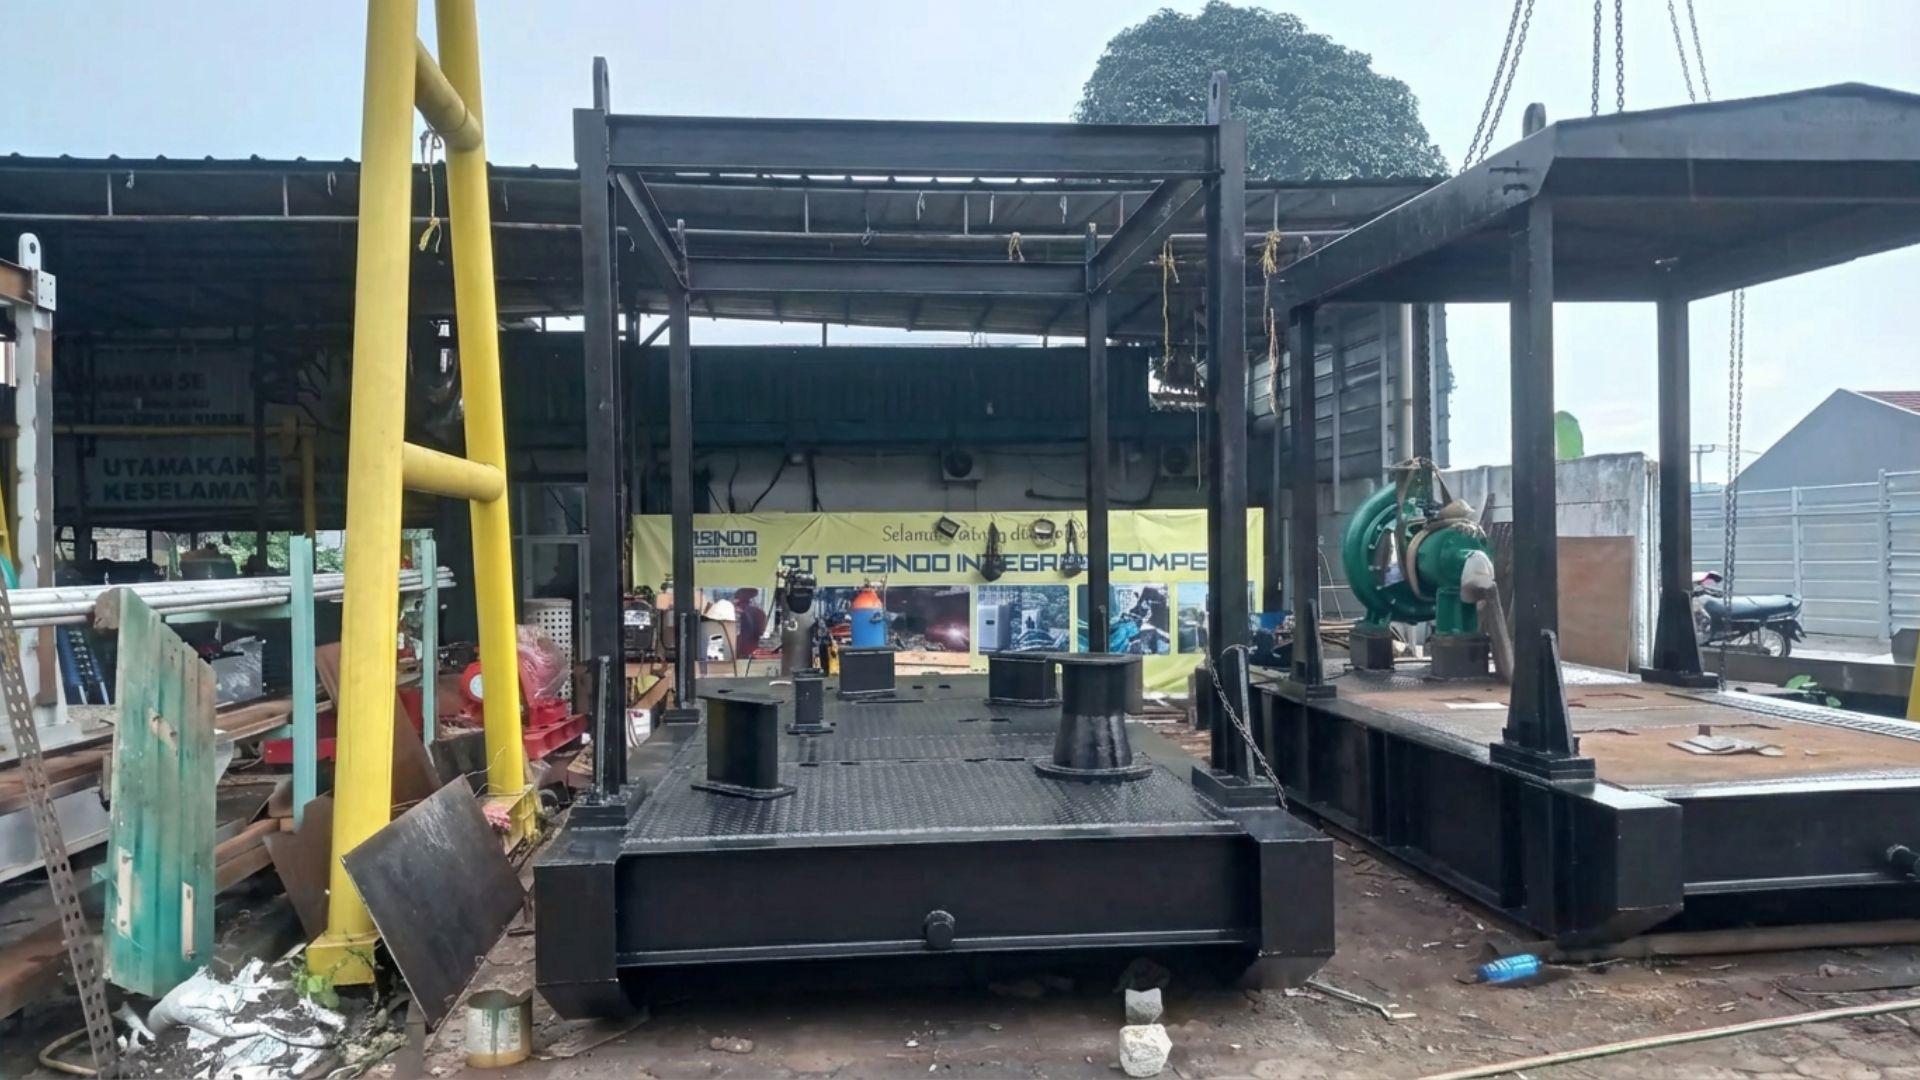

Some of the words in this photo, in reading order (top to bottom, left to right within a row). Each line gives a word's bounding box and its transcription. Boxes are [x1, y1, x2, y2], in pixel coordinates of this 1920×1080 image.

[103, 457, 256, 477] UTAMAKAN
[104, 481, 282, 502] KESELAMAA
[826, 554, 951, 574] ARSINDO
[1110, 553, 1208, 572] POMPE
